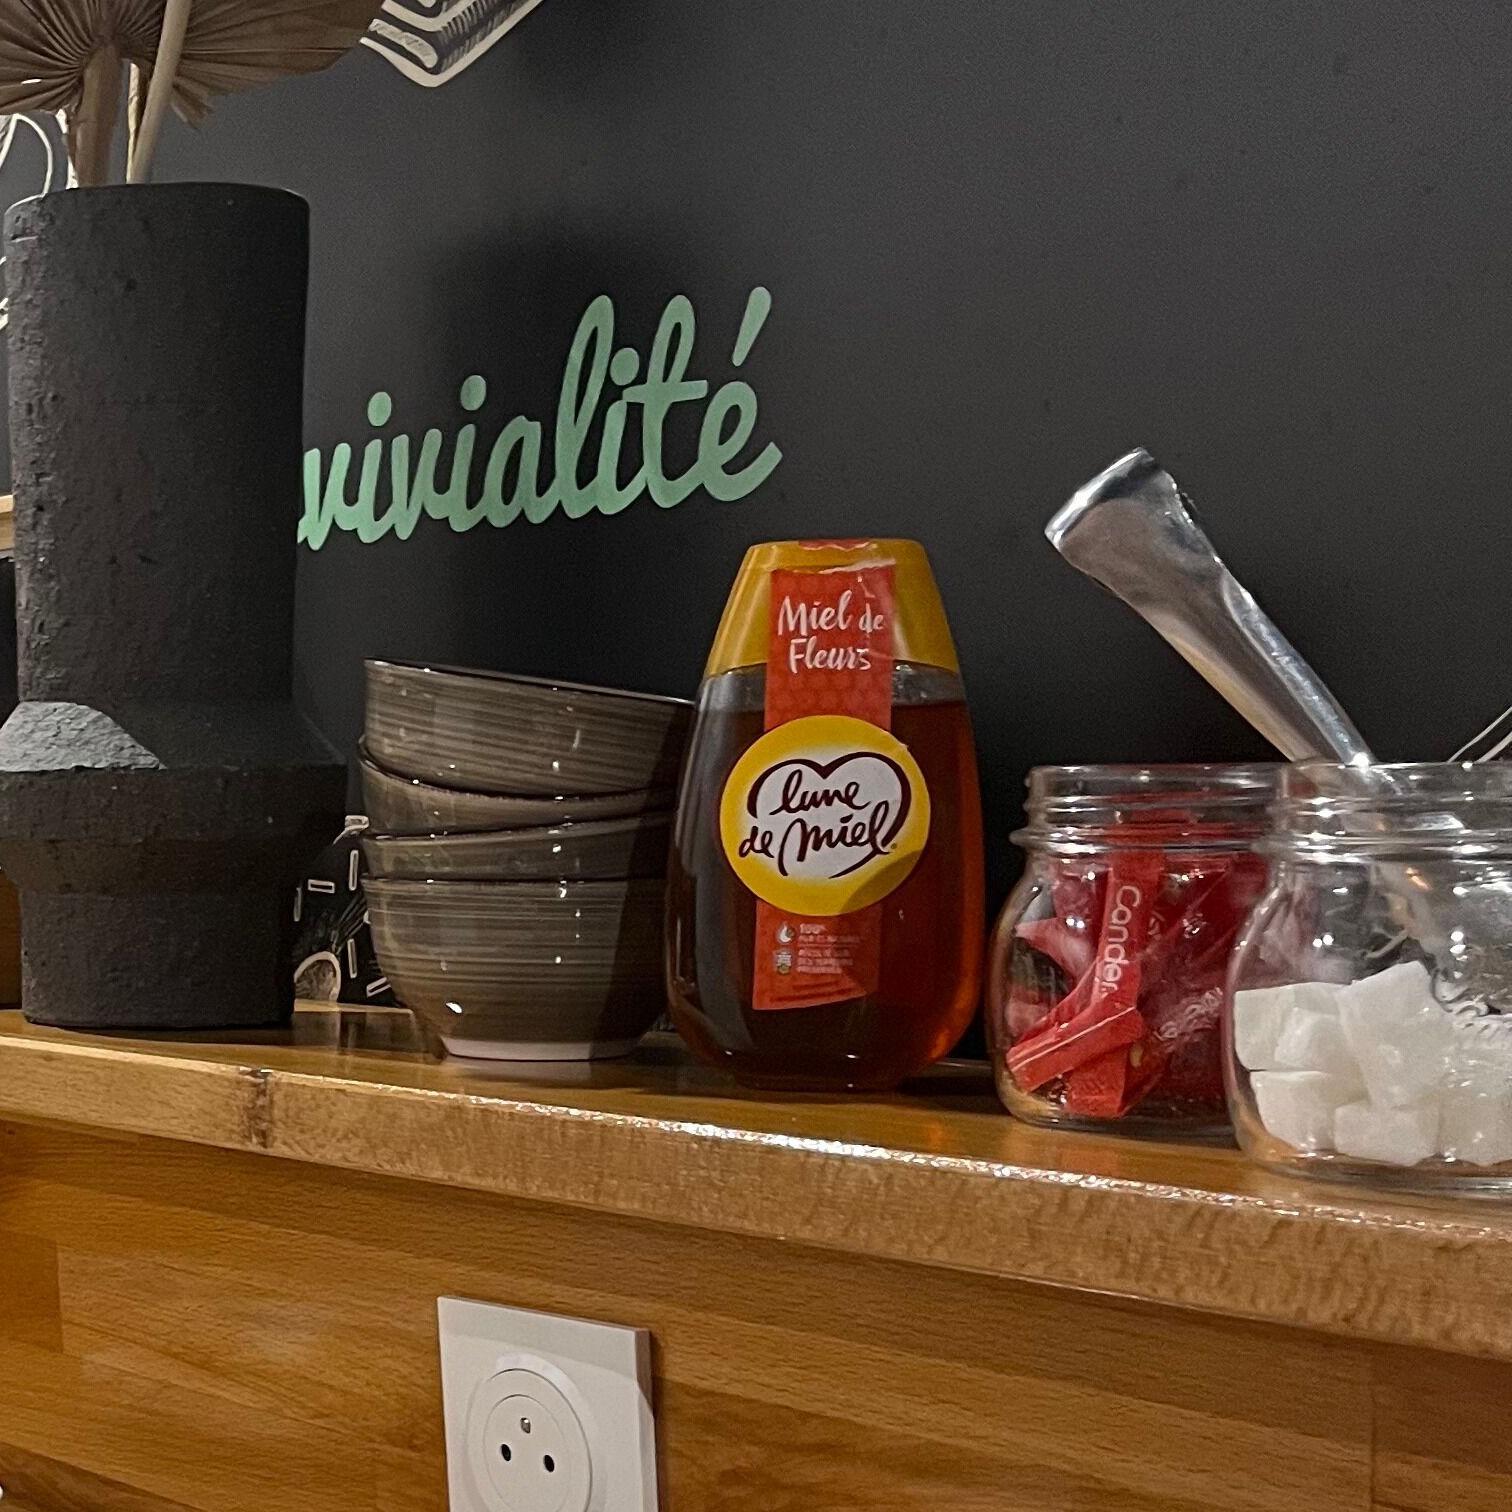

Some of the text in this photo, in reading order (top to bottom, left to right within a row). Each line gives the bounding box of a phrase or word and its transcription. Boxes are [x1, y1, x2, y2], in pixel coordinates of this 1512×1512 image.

[777, 589, 884, 636] Miel de
[790, 635, 872, 674] Fleurs
[739, 826, 775, 858] de
